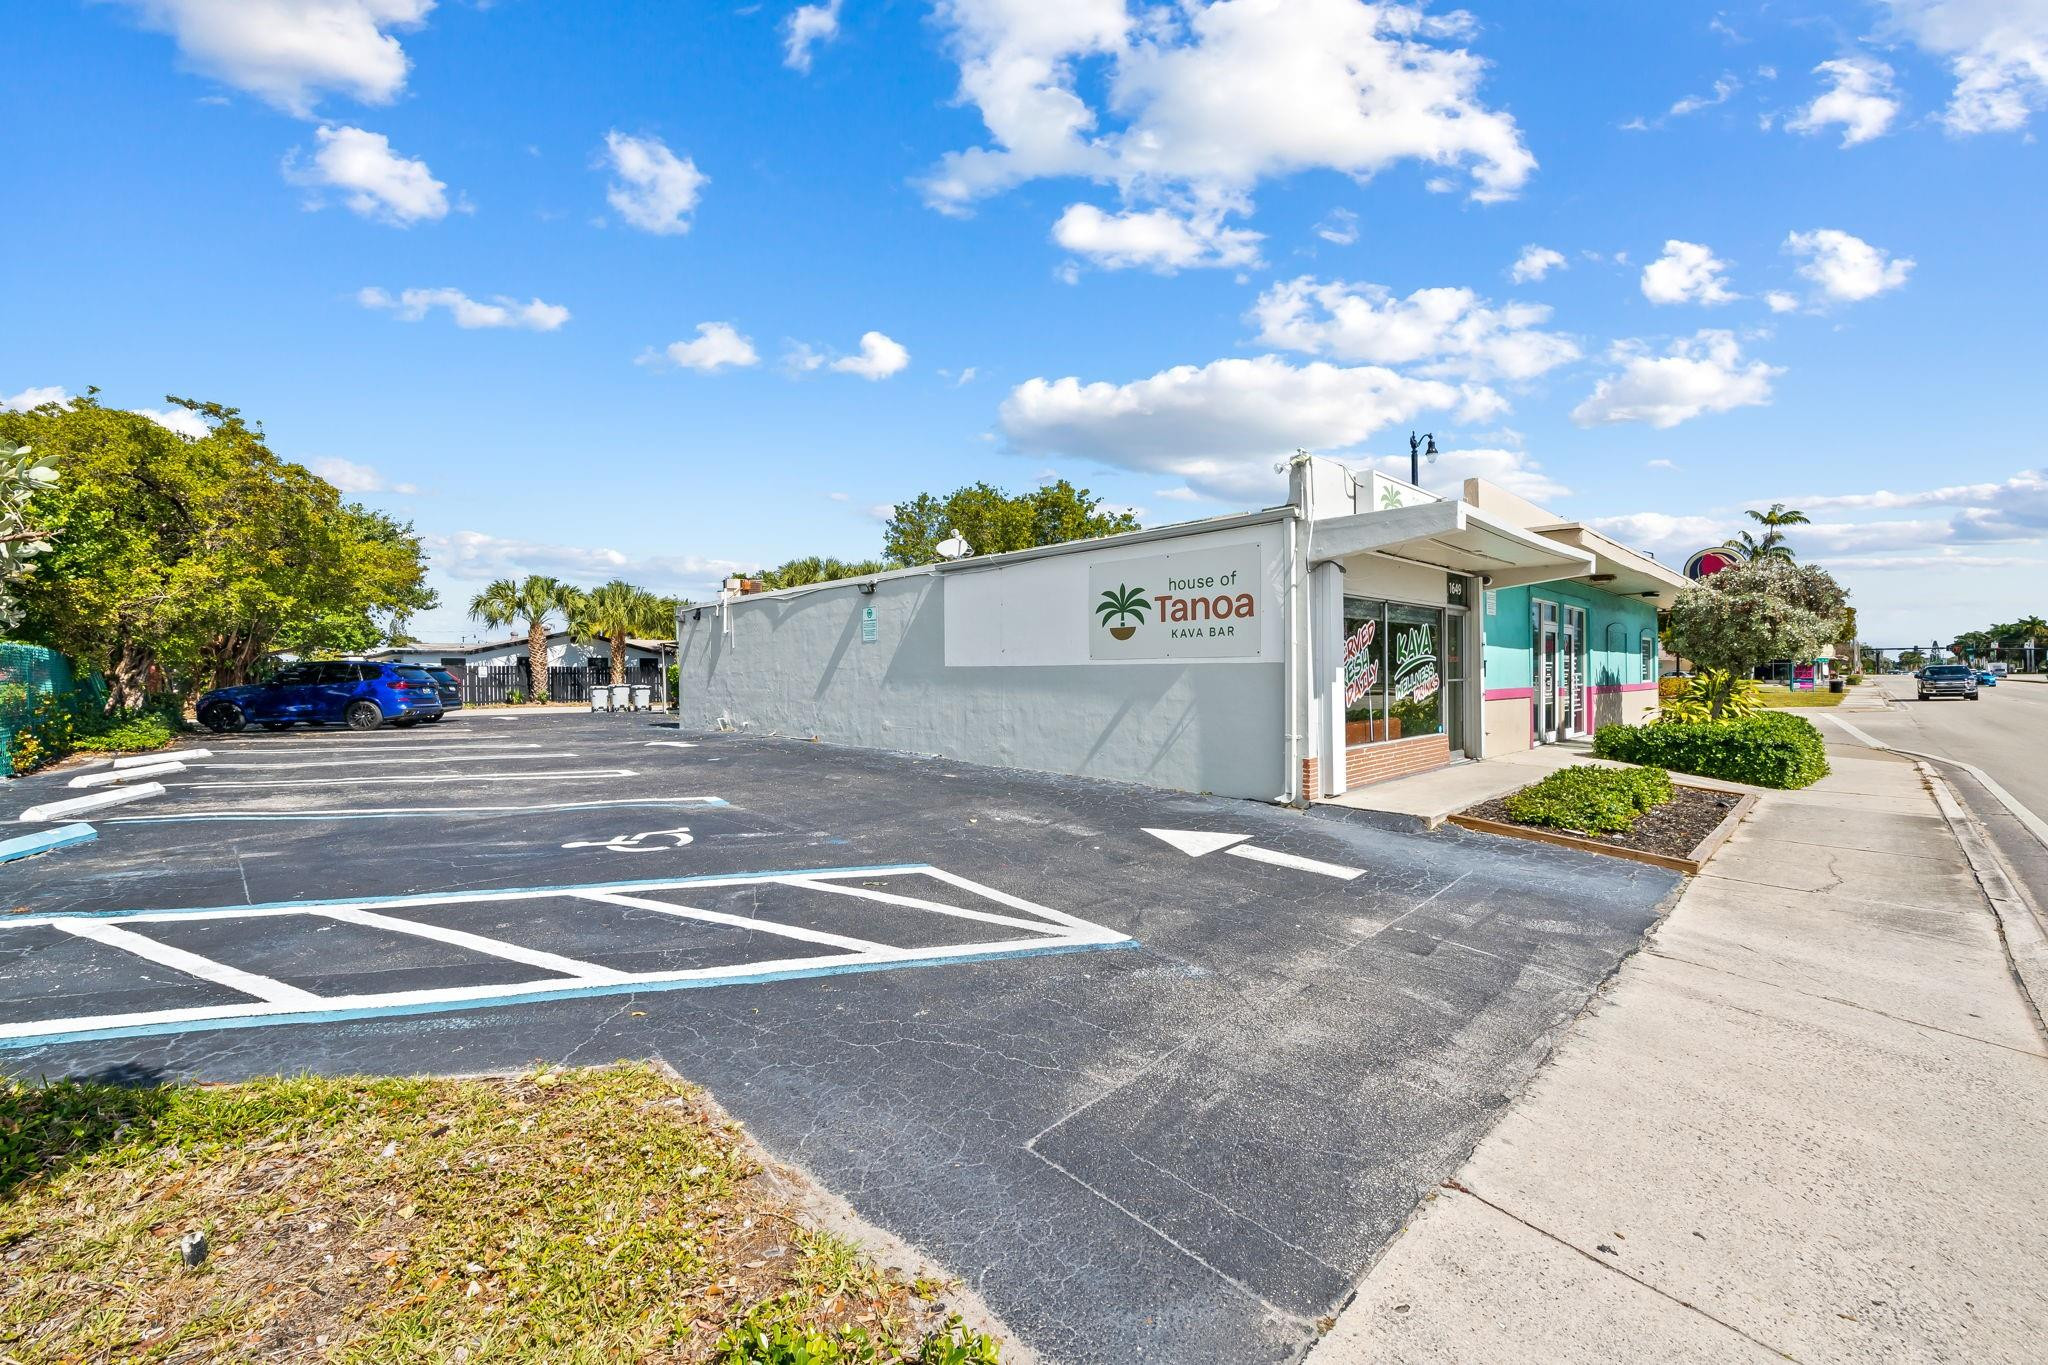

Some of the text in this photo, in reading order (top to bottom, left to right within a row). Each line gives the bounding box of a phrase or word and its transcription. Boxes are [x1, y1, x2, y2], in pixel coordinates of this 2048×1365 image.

[1168, 570, 1237, 591] house of
[1449, 582, 1462, 596] 1649
[1154, 593, 1255, 622] Tanoa
[1171, 626, 1235, 639] KAVA BAR
[1396, 623, 1432, 664] KAVA
[1344, 646, 1370, 688] ESH
[1394, 662, 1435, 701] WELLNESS
[1345, 659, 1379, 708] DAILY
[1413, 672, 1440, 704] DRINKS
